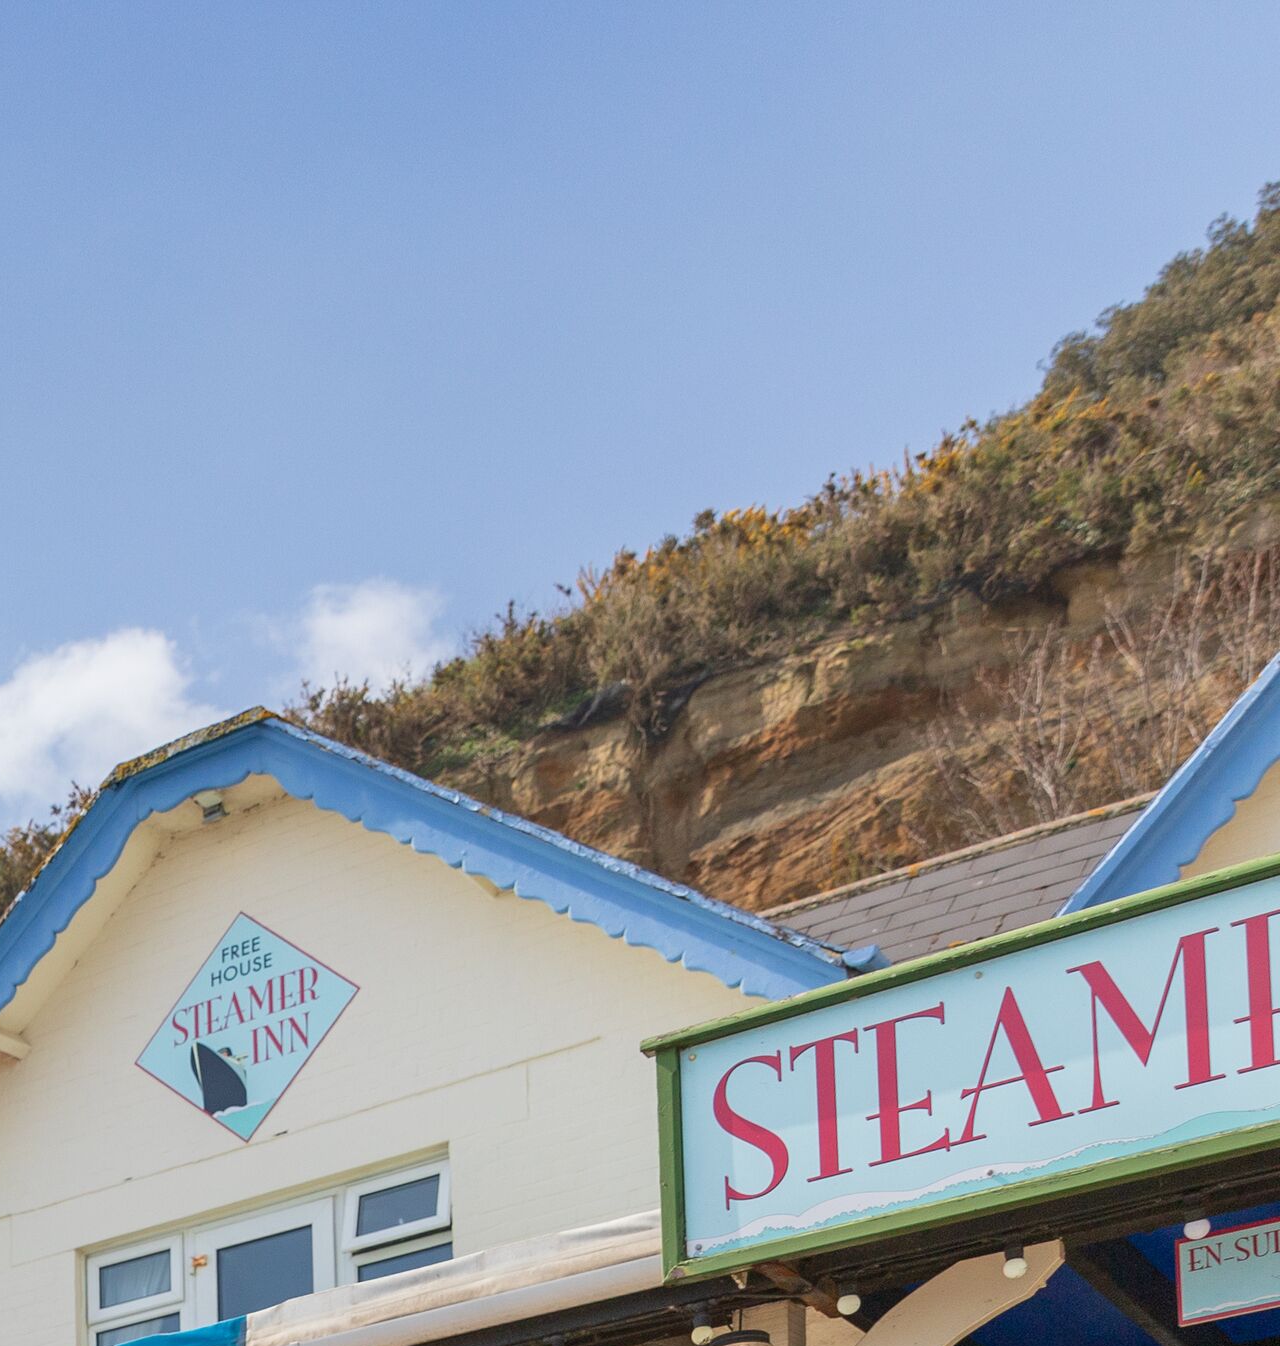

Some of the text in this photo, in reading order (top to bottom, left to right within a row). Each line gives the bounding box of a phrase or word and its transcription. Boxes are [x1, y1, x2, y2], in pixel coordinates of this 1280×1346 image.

[211, 953, 273, 987] HOUSE
[221, 936, 261, 963] FREE
[172, 966, 320, 1047] STEAMER
[250, 1011, 311, 1066] INN
[713, 907, 1280, 1211] STEAME
[1188, 1230, 1280, 1273] EN-SUI
